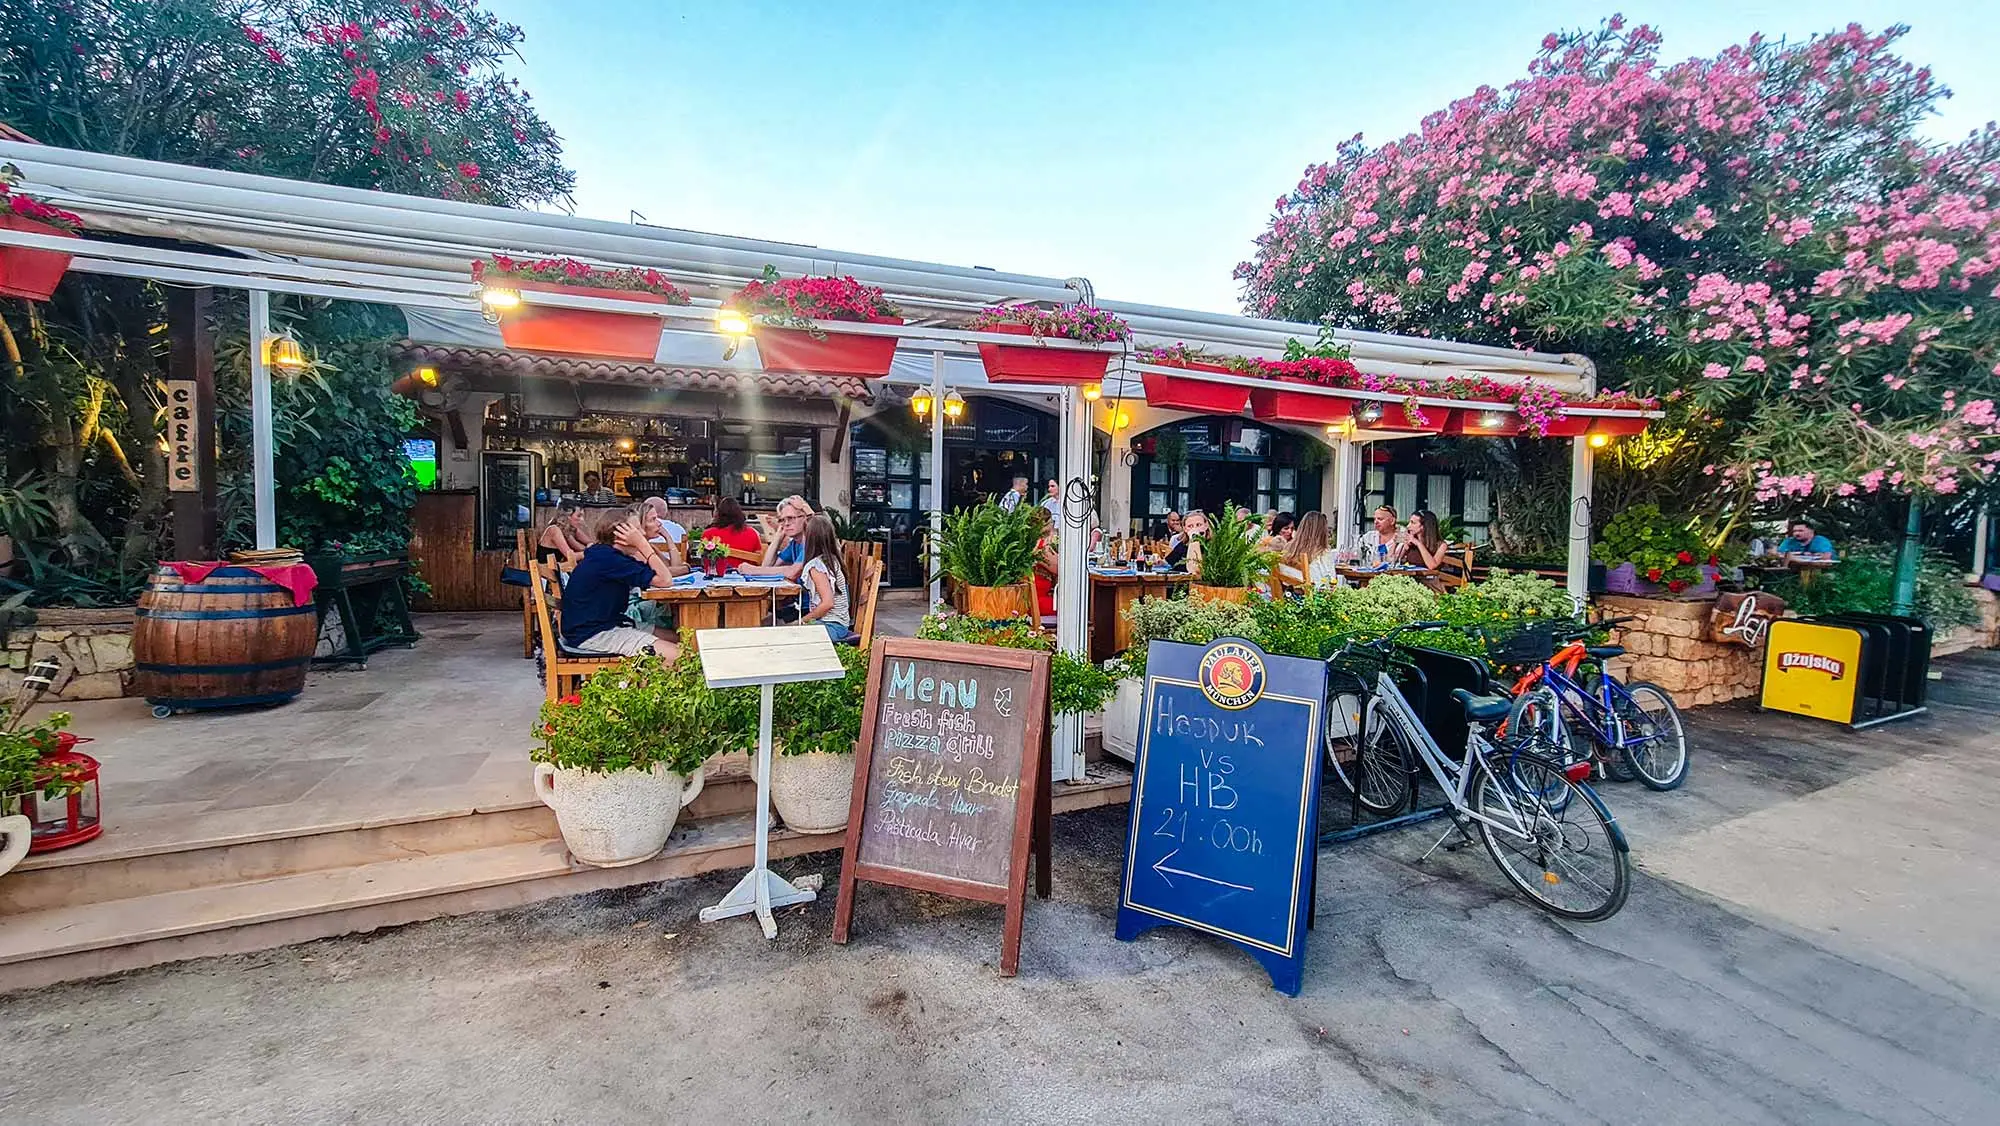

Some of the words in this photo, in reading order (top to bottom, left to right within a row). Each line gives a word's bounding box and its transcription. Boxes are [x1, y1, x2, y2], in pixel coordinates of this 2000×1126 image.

[173, 389, 191, 480] caffe
[1205, 647, 1261, 674] PAULANER
[888, 661, 978, 709] Menu
[1205, 684, 1255, 706] MÜNCHEN
[881, 703, 933, 729] Fresh
[937, 709, 976, 736] fish
[946, 733, 994, 763] grill
[964, 766, 1019, 801] Brudet
[1180, 763, 1239, 810] HB
